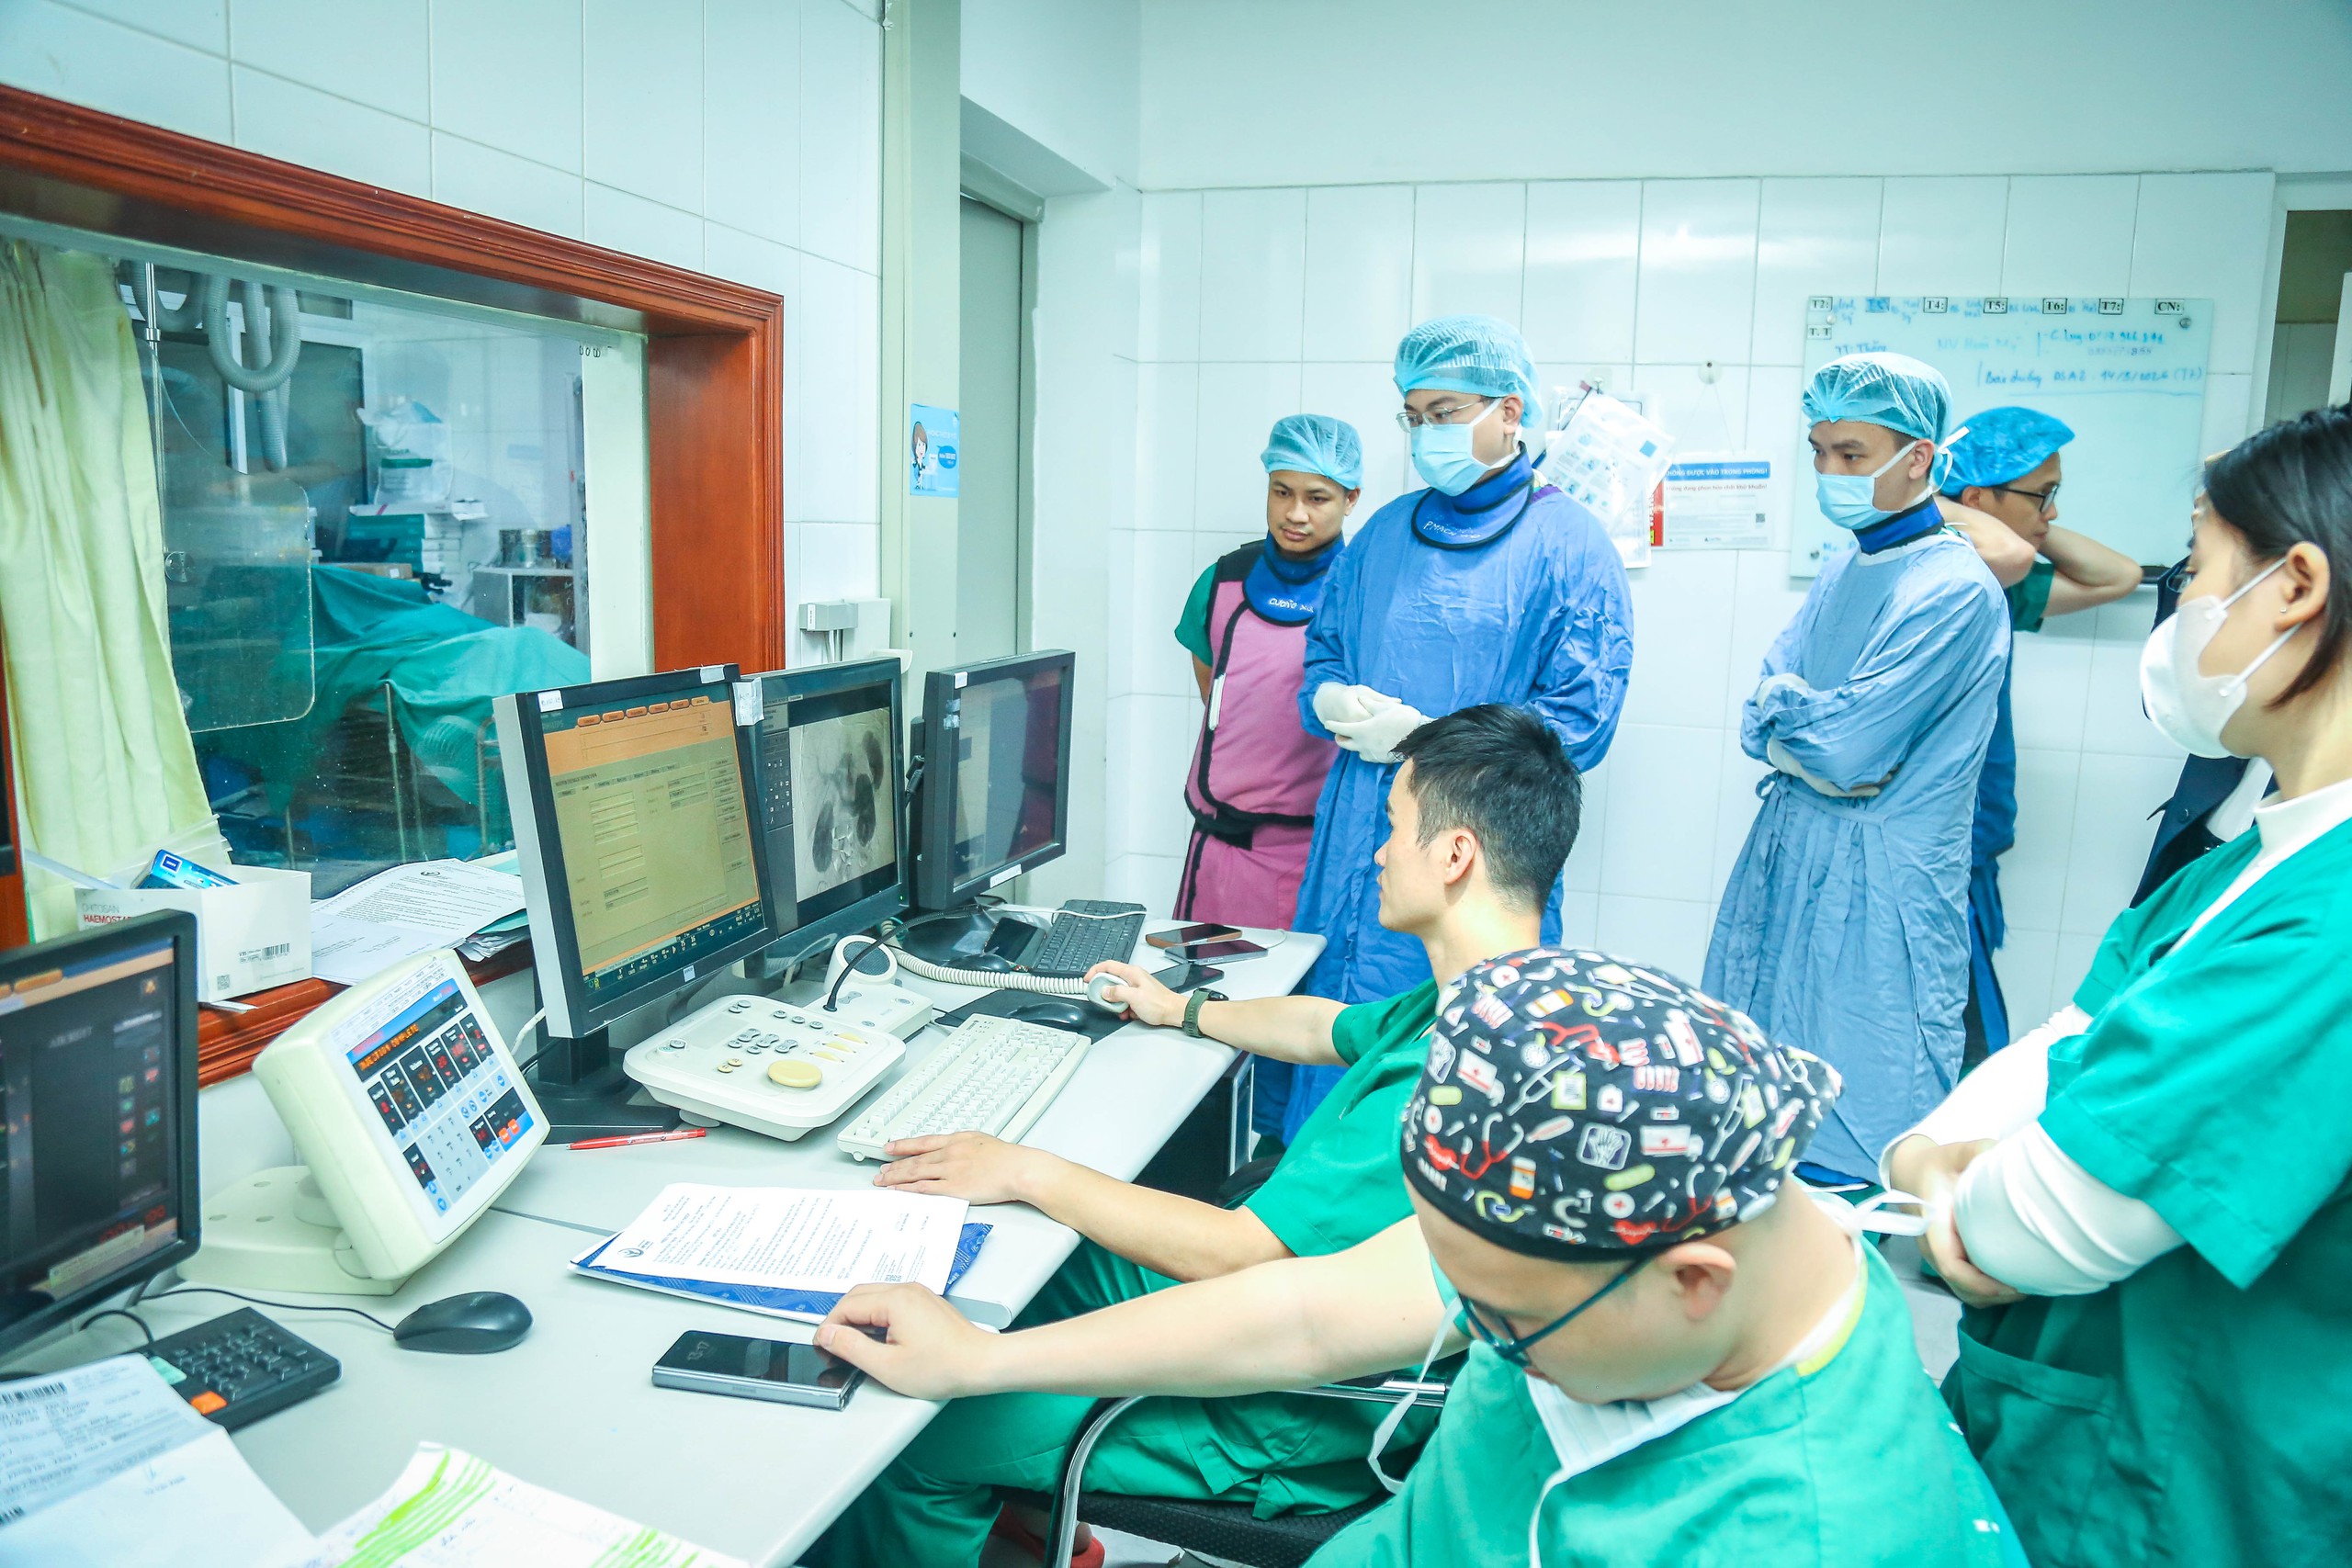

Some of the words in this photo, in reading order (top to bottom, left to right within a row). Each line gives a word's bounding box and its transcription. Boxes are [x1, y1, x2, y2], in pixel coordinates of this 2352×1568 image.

[1812, 299, 1829, 309] T2:
[1927, 300, 1944, 310] T4:
[1986, 300, 2005, 310] T5:
[2045, 301, 2064, 310] T6:
[2101, 301, 2120, 311] T7:
[2157, 301, 2180, 311] CN:
[1706, 467, 1720, 476] VÀO
[83, 914, 132, 924] HAEMOST
